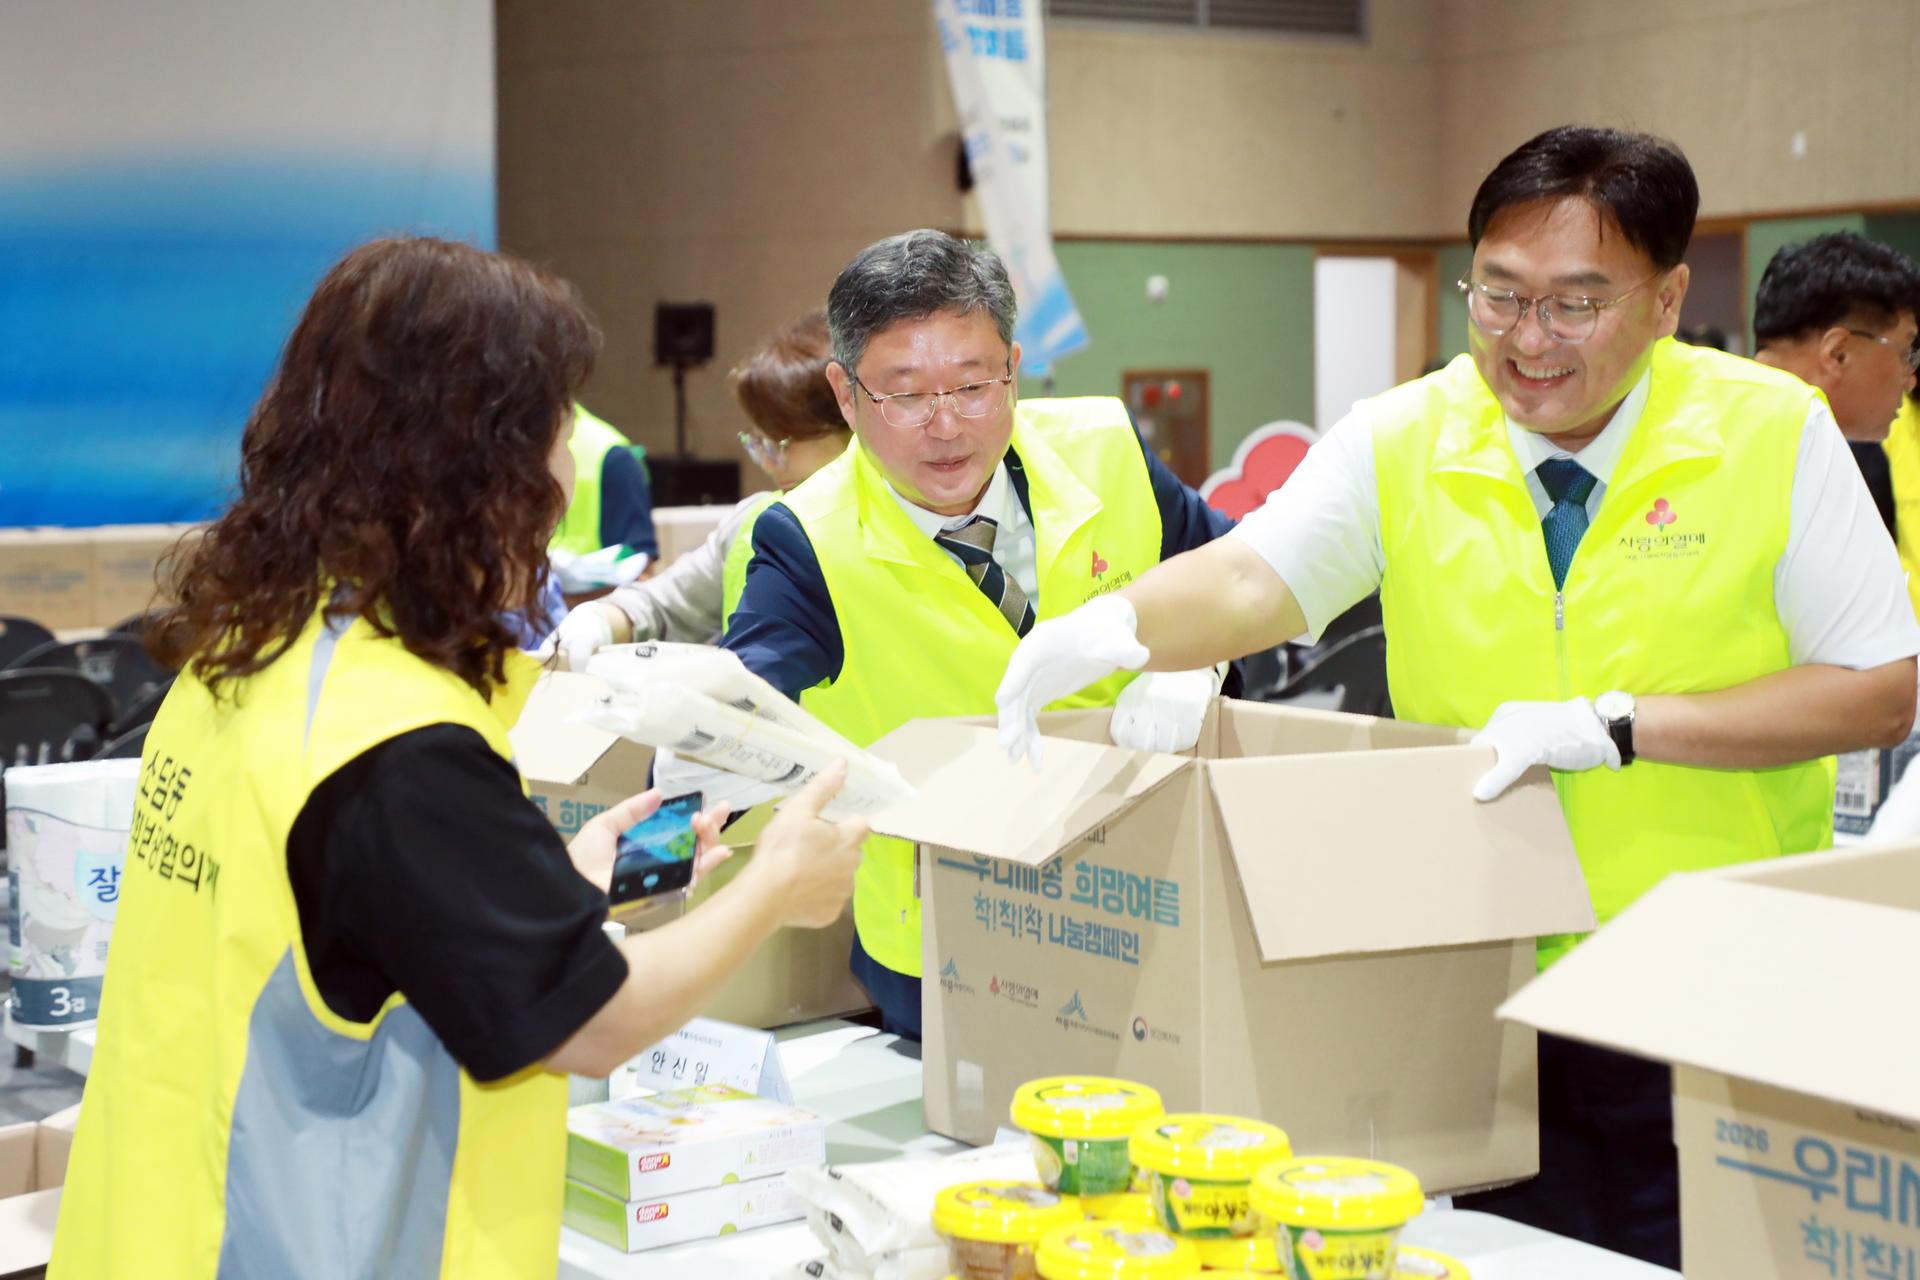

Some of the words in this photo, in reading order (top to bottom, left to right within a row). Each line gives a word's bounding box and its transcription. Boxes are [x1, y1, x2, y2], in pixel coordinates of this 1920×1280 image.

[140, 749, 192, 821] 소담동
[1070, 860, 1180, 928] 희망여름
[1048, 912, 1139, 965] 나눔캠페인
